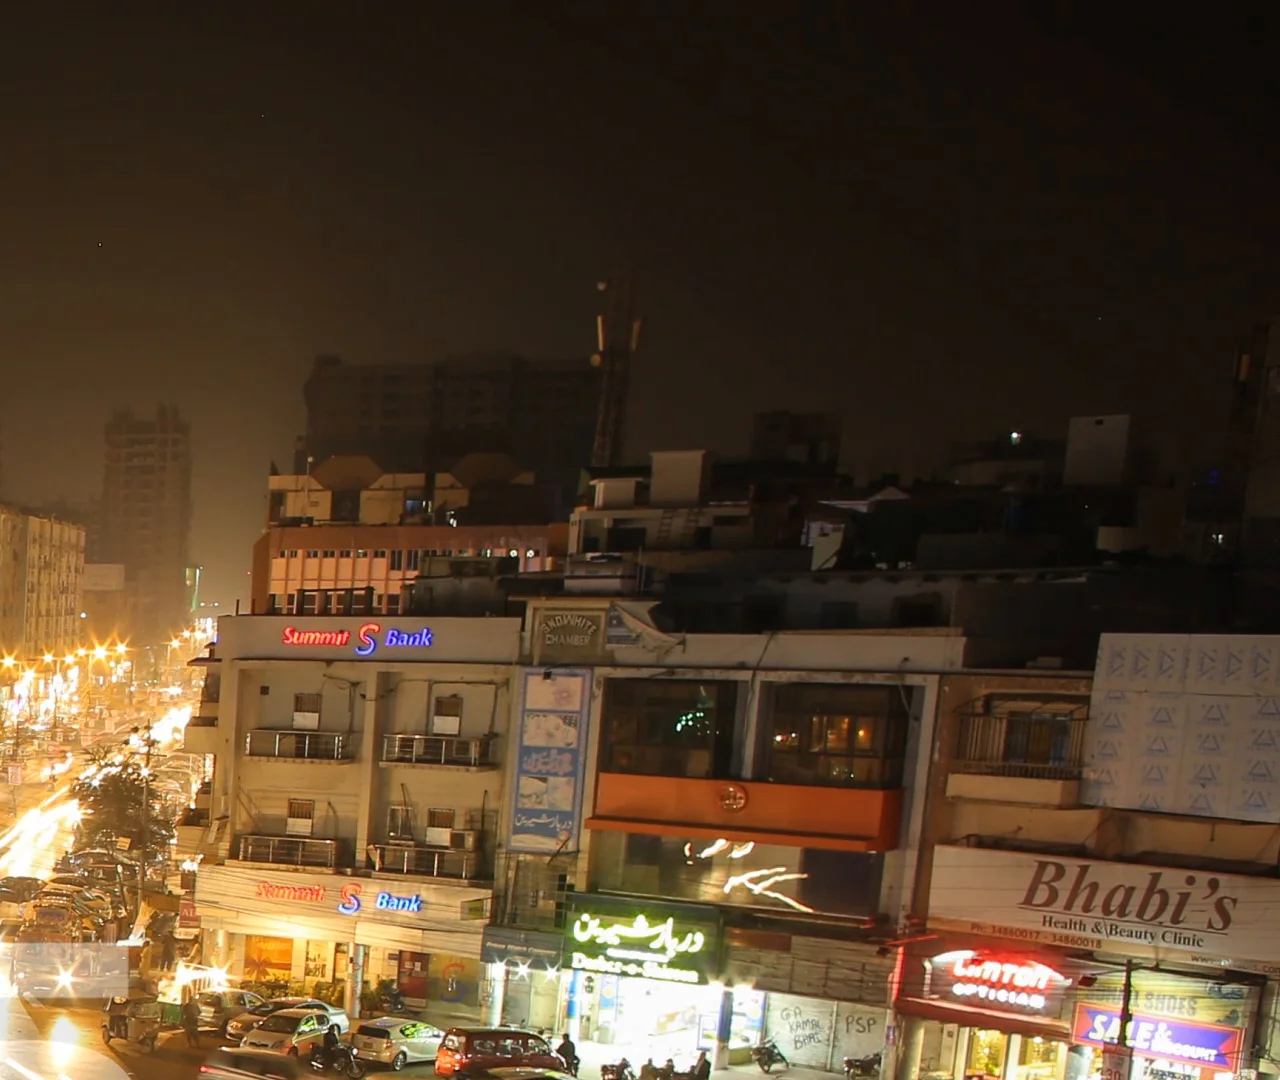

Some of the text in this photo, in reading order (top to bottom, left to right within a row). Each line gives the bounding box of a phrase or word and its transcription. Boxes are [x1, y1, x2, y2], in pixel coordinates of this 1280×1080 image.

[283, 626, 350, 646] Summit
[385, 627, 433, 646] Bank
[546, 634, 590, 645] CHAMBER
[256, 880, 326, 902] Summit
[376, 891, 423, 912] Bank
[1021, 859, 1238, 931] Bhabi's
[970, 922, 986, 933] Ph:
[990, 924, 1040, 940] 34860017
[1052, 933, 1102, 949] 34860018
[1042, 915, 1204, 948] Health & Beauty Clinic
[1144, 991, 1197, 1017] SHOES
[845, 1015, 876, 1033] PSP
[1089, 1015, 1154, 1049] SALE
